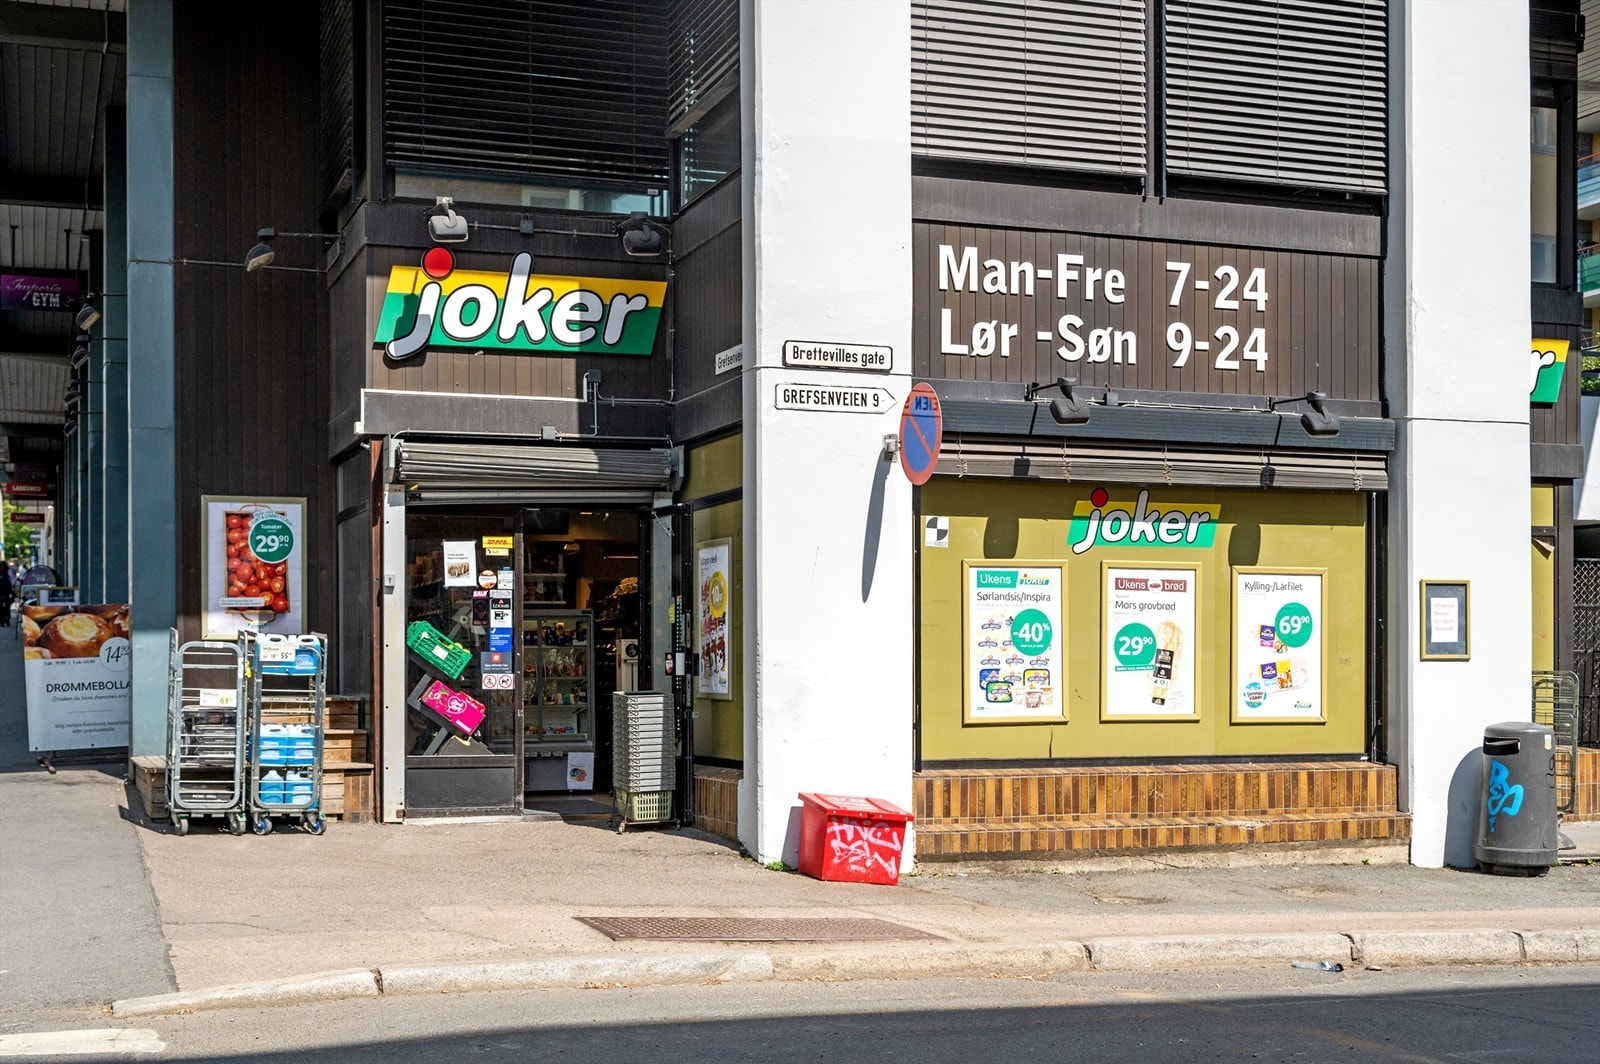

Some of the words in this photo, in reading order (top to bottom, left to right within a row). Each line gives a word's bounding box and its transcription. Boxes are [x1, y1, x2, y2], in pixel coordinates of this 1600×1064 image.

[939, 244, 1126, 304] Man-Fre
[1166, 261, 1269, 312] 7-24
[32, 292, 60, 307] GYM
[386, 247, 648, 360] joker
[941, 308, 1018, 357] Lør
[1166, 321, 1269, 372] 9-24
[792, 346, 858, 363] Brettevilles
[861, 351, 885, 368] gate
[783, 388, 868, 408] GREFSENVEIEN
[873, 393, 880, 407] 9
[1072, 488, 1212, 554] joker
[980, 573, 1011, 584] Ukens
[1118, 579, 1147, 590] Ukens
[1164, 581, 1185, 591] brød
[976, 591, 1051, 603] Sørlandsis/Inspira
[1115, 600, 1137, 610] Mors
[1138, 600, 1176, 612] grovbrød
[1012, 622, 1051, 643] -40%
